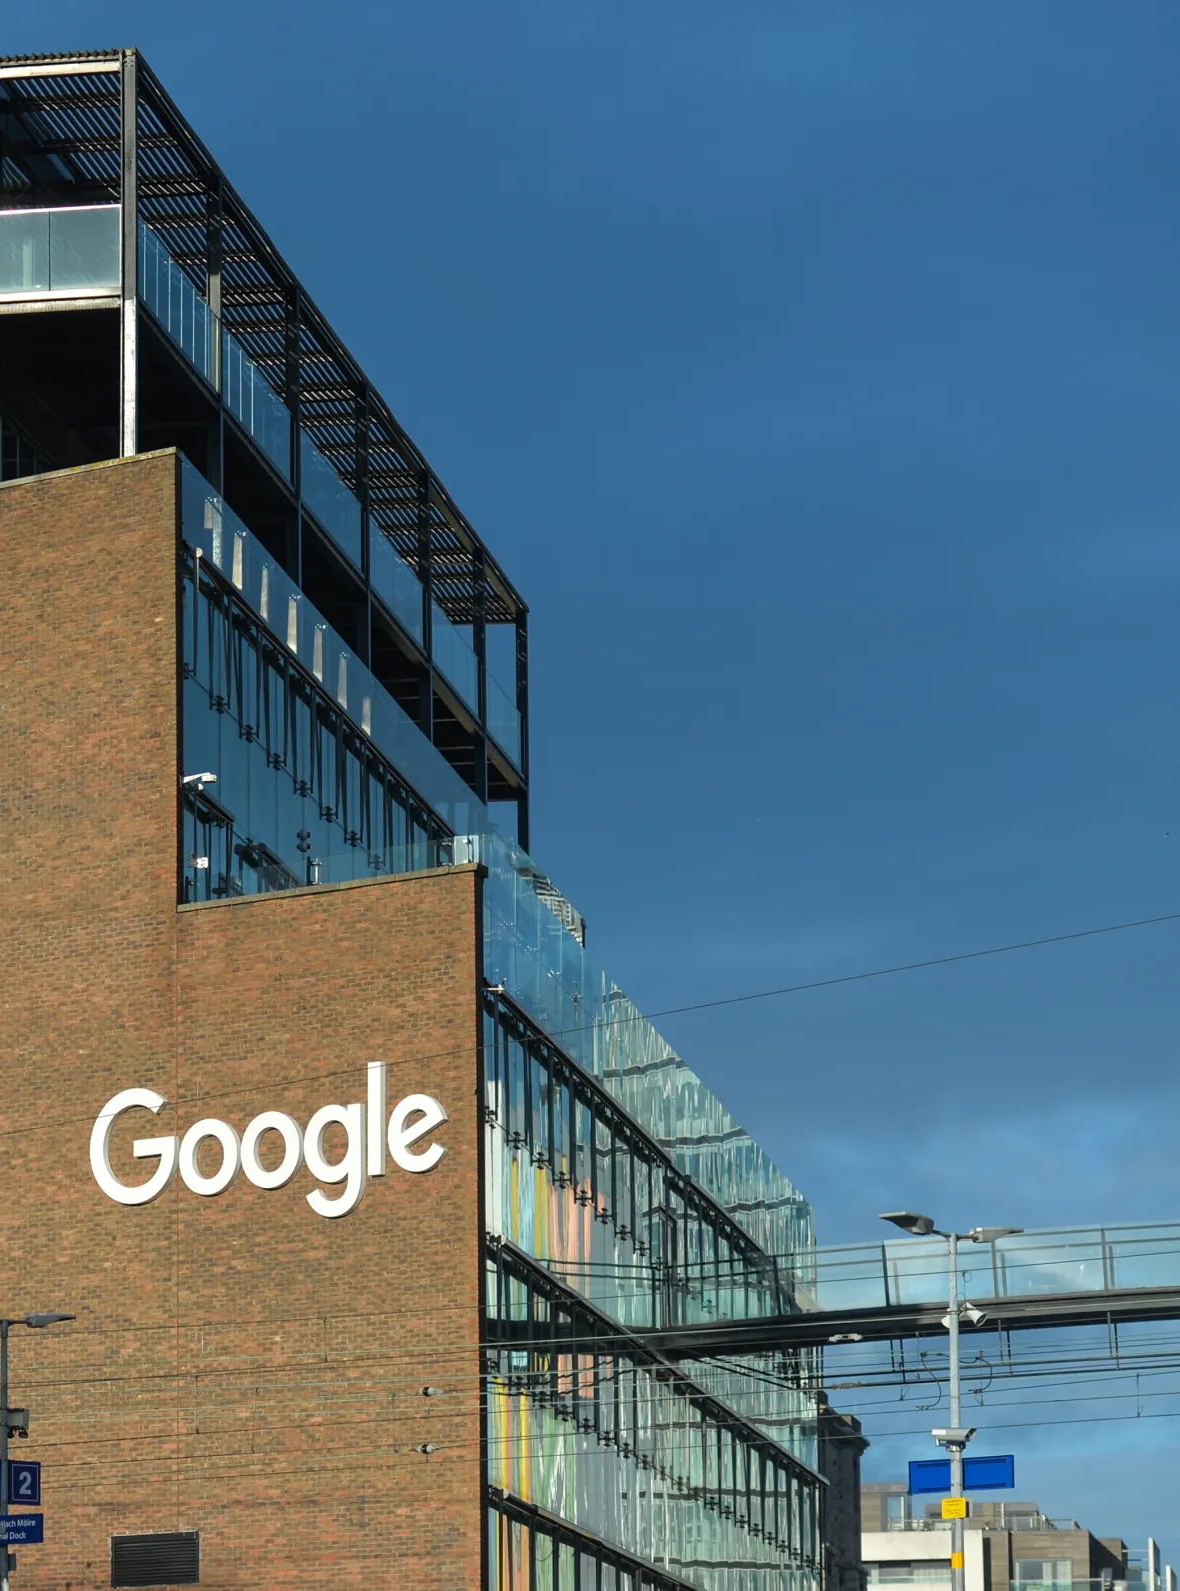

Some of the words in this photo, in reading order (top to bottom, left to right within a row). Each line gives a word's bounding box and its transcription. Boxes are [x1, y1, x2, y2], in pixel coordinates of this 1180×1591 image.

[89, 1060, 449, 1219] Google
[19, 1471, 32, 1495] 2
[9, 1531, 26, 1540] Dock
